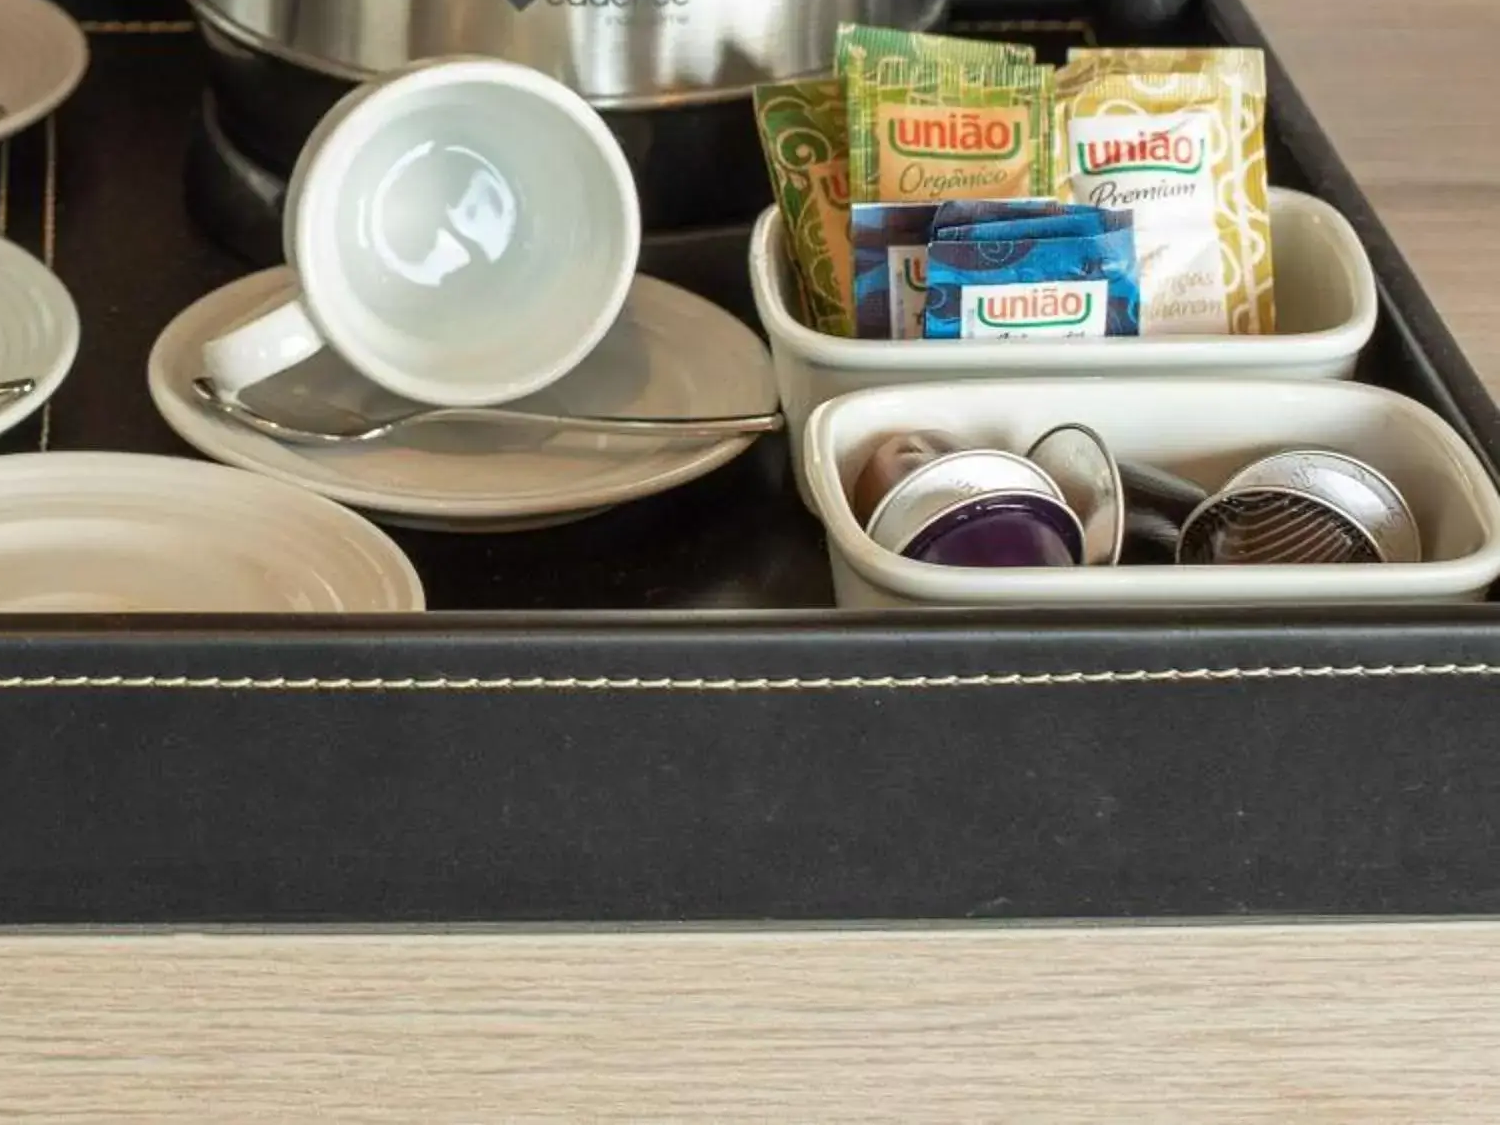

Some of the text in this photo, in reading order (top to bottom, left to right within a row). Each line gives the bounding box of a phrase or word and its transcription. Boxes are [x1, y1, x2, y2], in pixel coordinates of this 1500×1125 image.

[898, 113, 1010, 150] união
[1088, 130, 1192, 169] união
[899, 163, 1008, 198] Orgânico
[1089, 178, 1196, 209] Premium
[987, 286, 1083, 320] união
